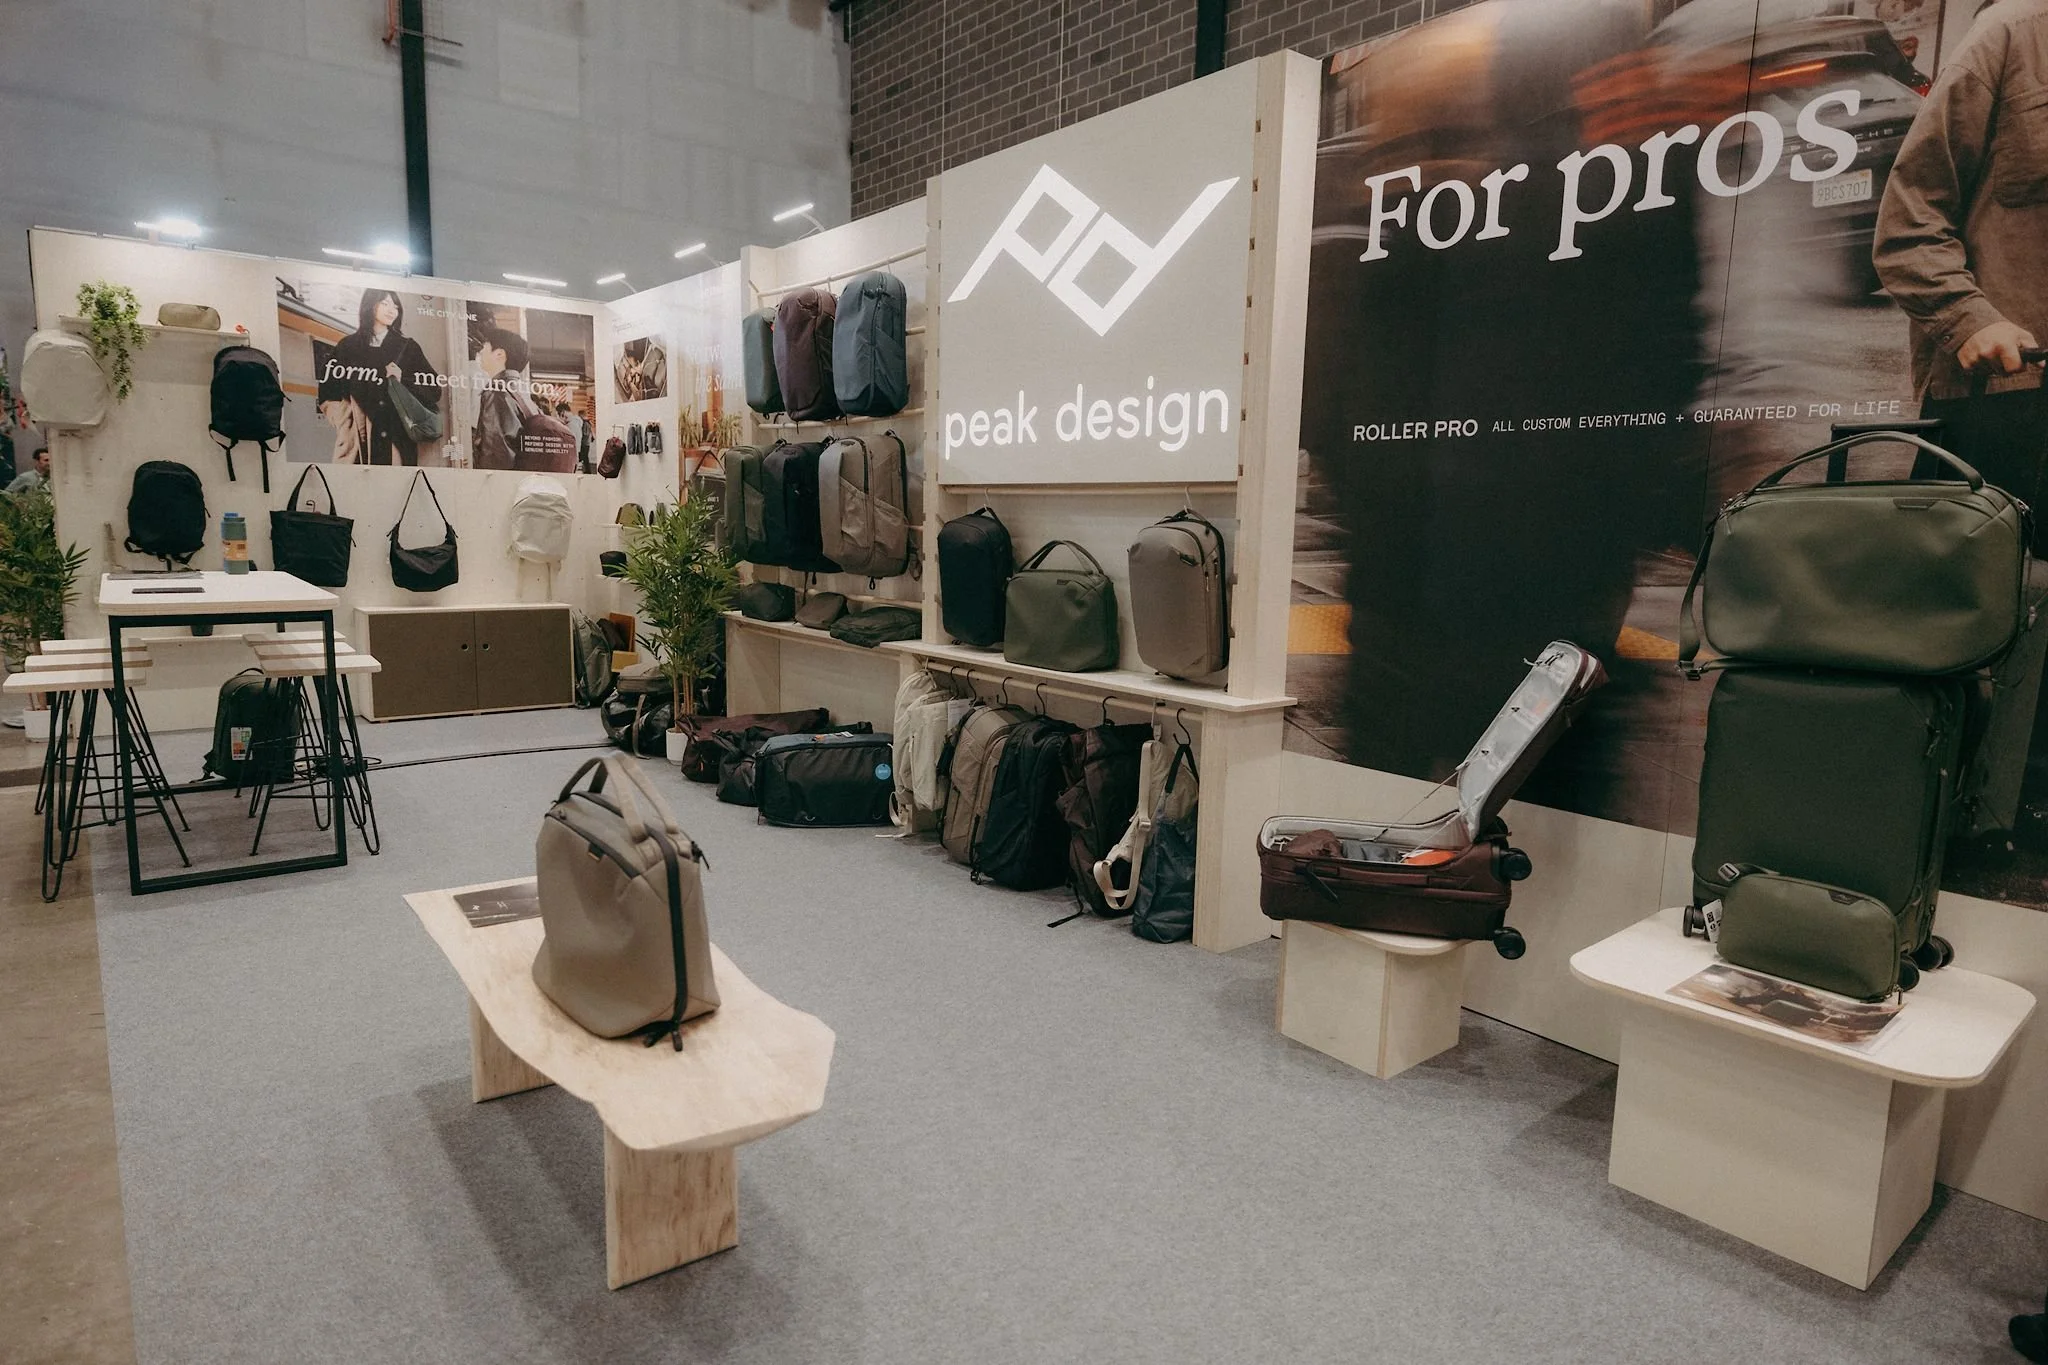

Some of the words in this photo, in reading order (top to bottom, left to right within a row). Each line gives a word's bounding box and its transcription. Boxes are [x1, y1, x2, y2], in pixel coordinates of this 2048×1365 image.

[1360, 164, 1530, 262] For
[1549, 89, 1861, 261] pros
[417, 307, 435, 317] THE
[436, 309, 456, 318] CITY
[459, 312, 478, 322] LINE
[319, 358, 384, 386] form,
[414, 370, 468, 389] meet
[946, 390, 1038, 460] peak
[1056, 375, 1229, 451] design
[1353, 421, 1428, 442] ROLLER
[1434, 418, 1479, 438] PRO
[1492, 420, 1516, 433] ALL
[1522, 416, 1571, 431] CUSTOM
[1578, 411, 1667, 429] EVERYTHING
[1693, 405, 1797, 424] GUARANTEED
[1808, 403, 1841, 418] FOR
[1853, 400, 1901, 416] LIFE
